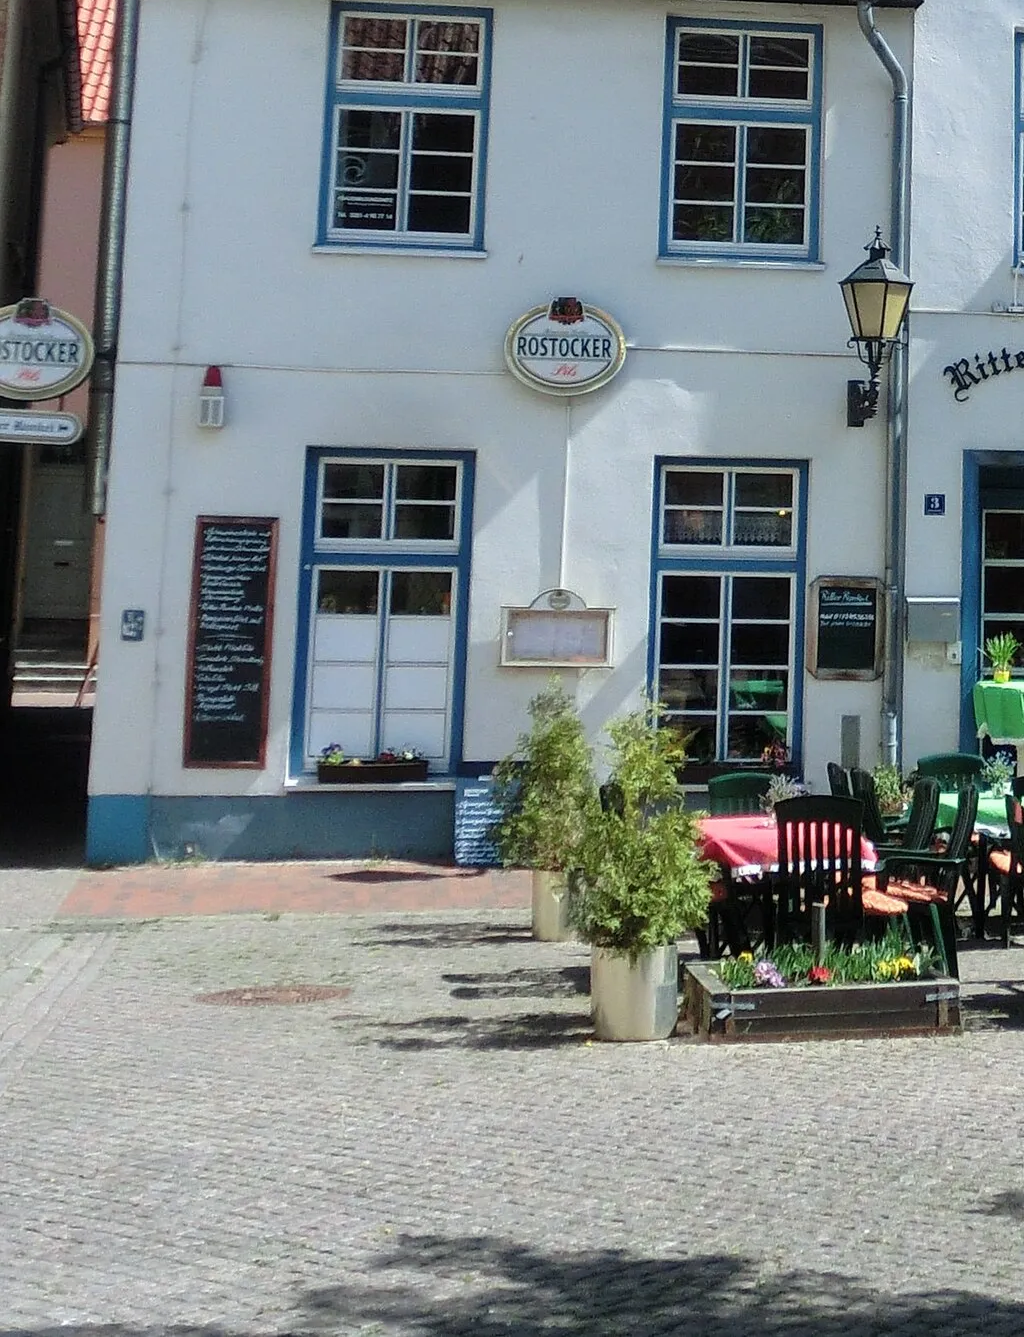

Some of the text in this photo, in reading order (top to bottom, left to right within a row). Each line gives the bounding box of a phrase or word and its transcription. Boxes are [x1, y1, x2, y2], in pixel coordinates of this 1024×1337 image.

[0, 341, 79, 363] STOCKER
[517, 337, 611, 358] ROSTOCKER
[930, 497, 940, 509] 3
